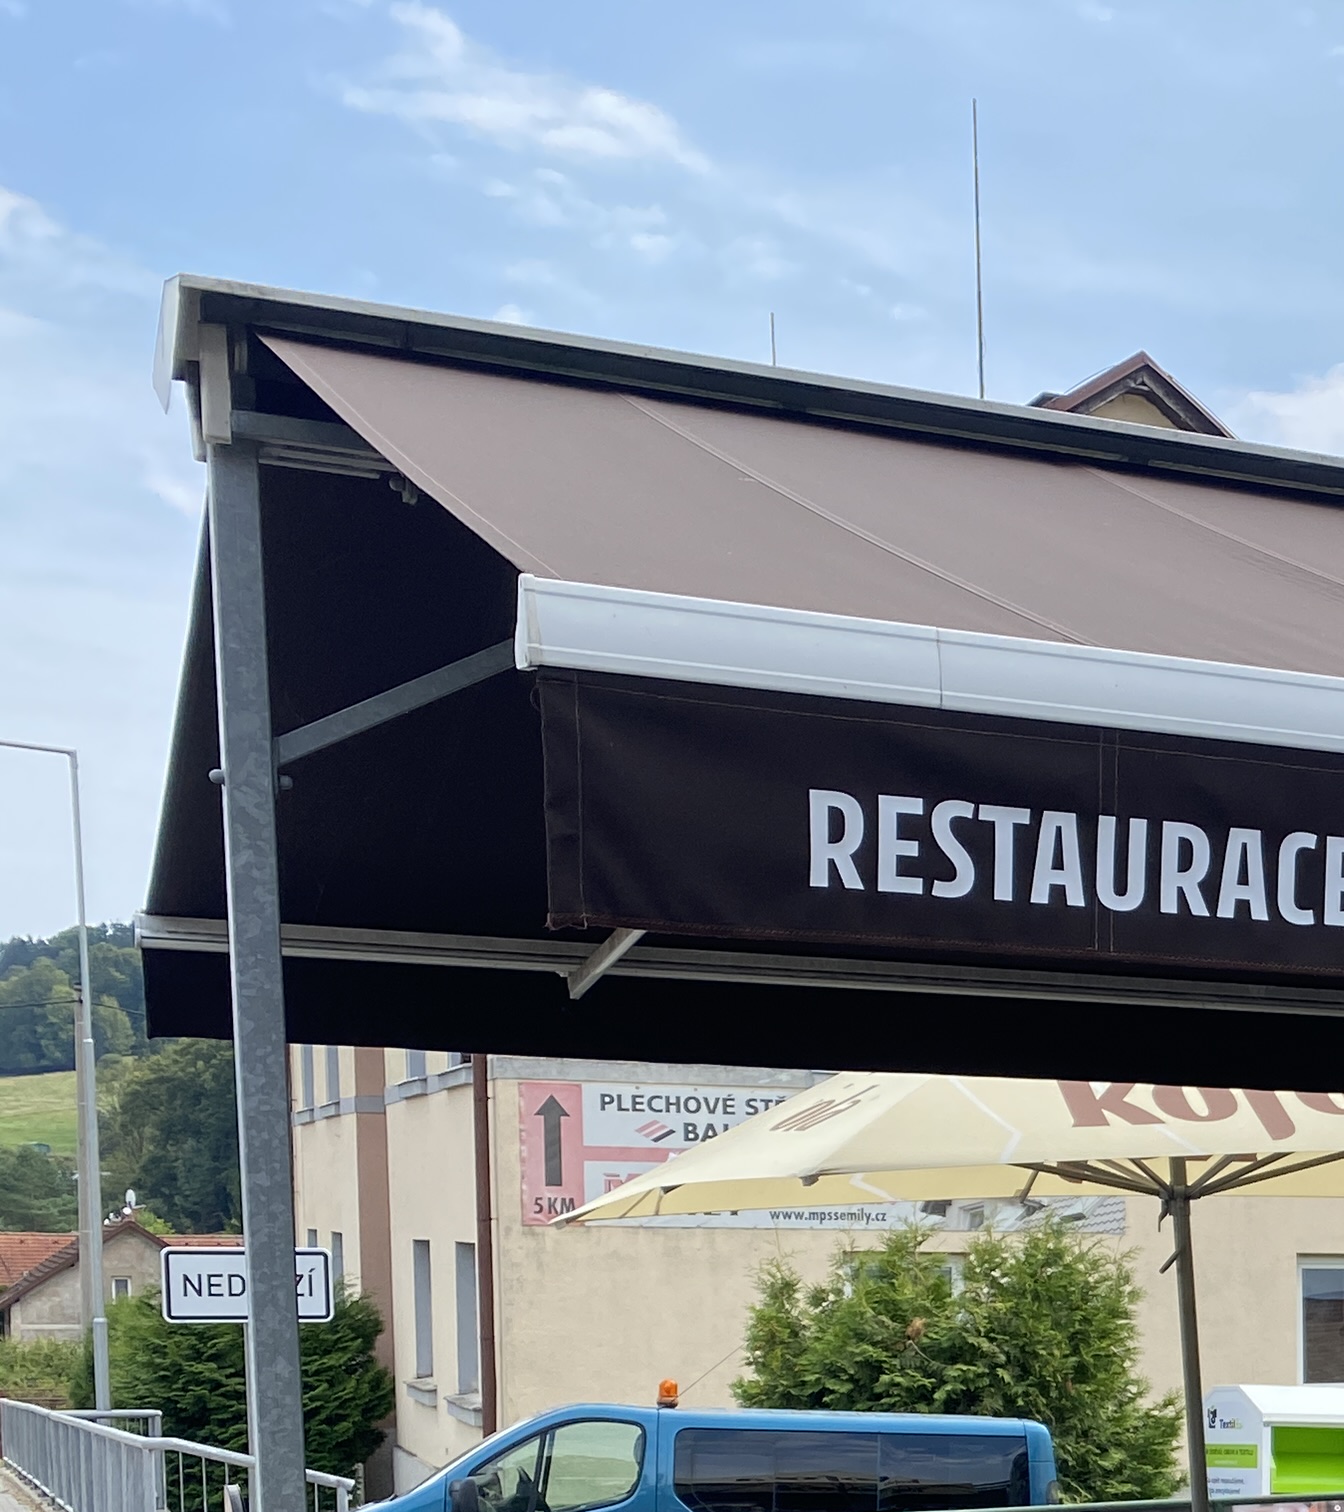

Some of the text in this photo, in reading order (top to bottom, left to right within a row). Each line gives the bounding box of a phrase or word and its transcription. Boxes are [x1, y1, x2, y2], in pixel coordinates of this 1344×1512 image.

[600, 1092, 736, 1115] PLECHOVÉ
[533, 1197, 575, 1214] 5 KM
[769, 1208, 888, 1224] www.mpssemily.cz
[182, 1267, 315, 1298] NEDZÍ
